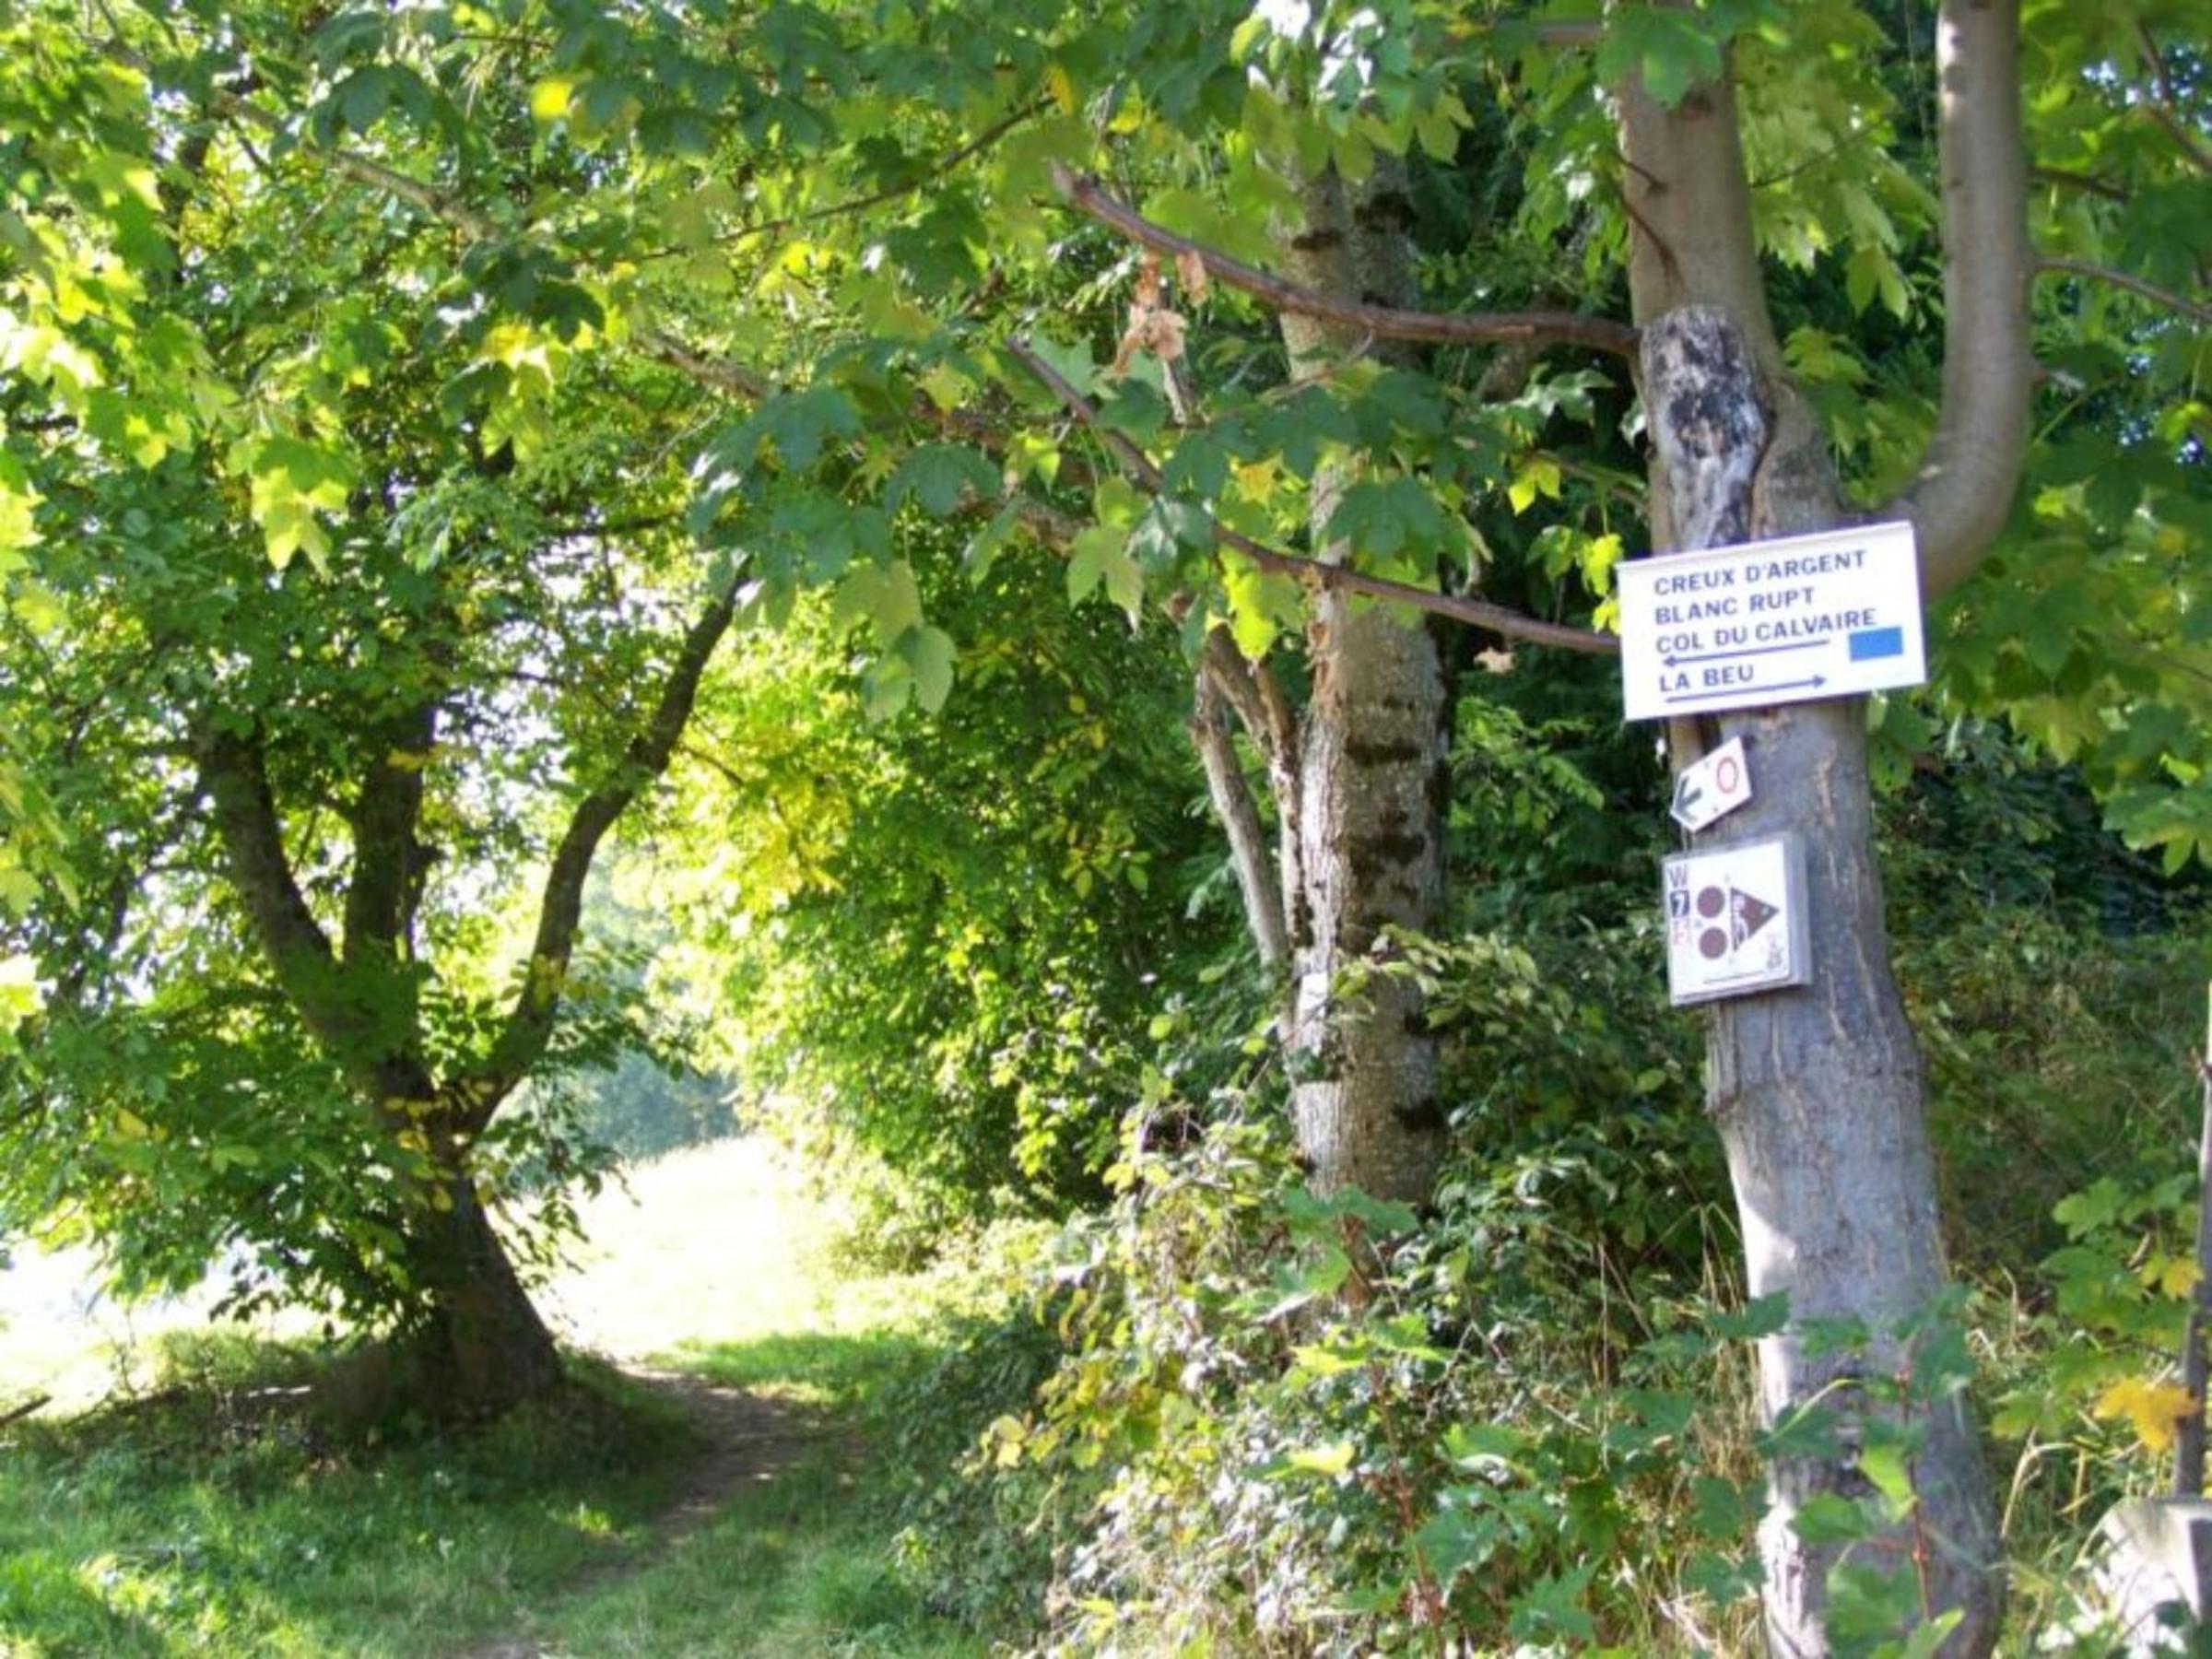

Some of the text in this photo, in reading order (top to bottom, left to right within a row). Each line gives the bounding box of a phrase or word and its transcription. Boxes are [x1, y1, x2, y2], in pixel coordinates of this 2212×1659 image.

[1654, 549, 1867, 595] CREUX D'ARGENT
[1655, 587, 1816, 626] BLANC RUPT
[1656, 608, 1877, 653] COL DU CALVAIRE
[1660, 665, 1754, 691] LA BEU
